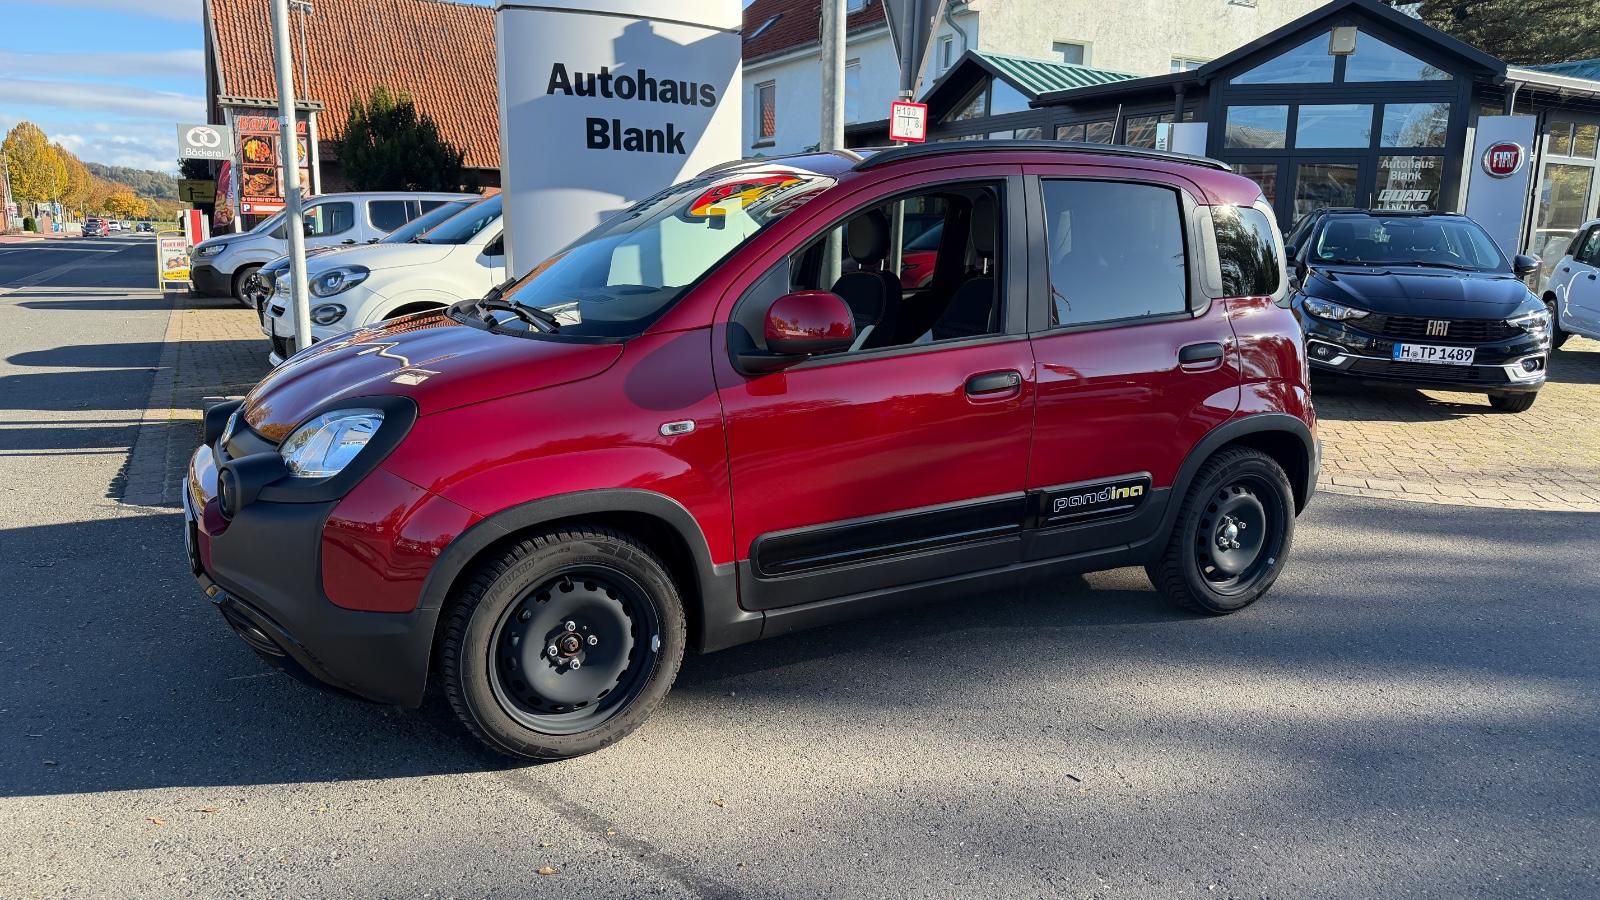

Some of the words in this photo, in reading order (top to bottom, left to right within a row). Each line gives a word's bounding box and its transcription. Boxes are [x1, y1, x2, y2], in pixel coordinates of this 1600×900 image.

[547, 62, 717, 108] Autohaus
[586, 117, 686, 154] Blank
[185, 147, 224, 157] Bäckerei
[1493, 151, 1517, 168] FIAT
[1380, 160, 1435, 169] Autohaus
[1391, 170, 1422, 180] Blank
[1378, 190, 1431, 201] FIAT
[1426, 320, 1450, 336] FIAT
[1400, 345, 1411, 358] H
[1419, 346, 1437, 359] TP
[1438, 347, 1473, 362] 1489
[1053, 485, 1144, 513] pandina
